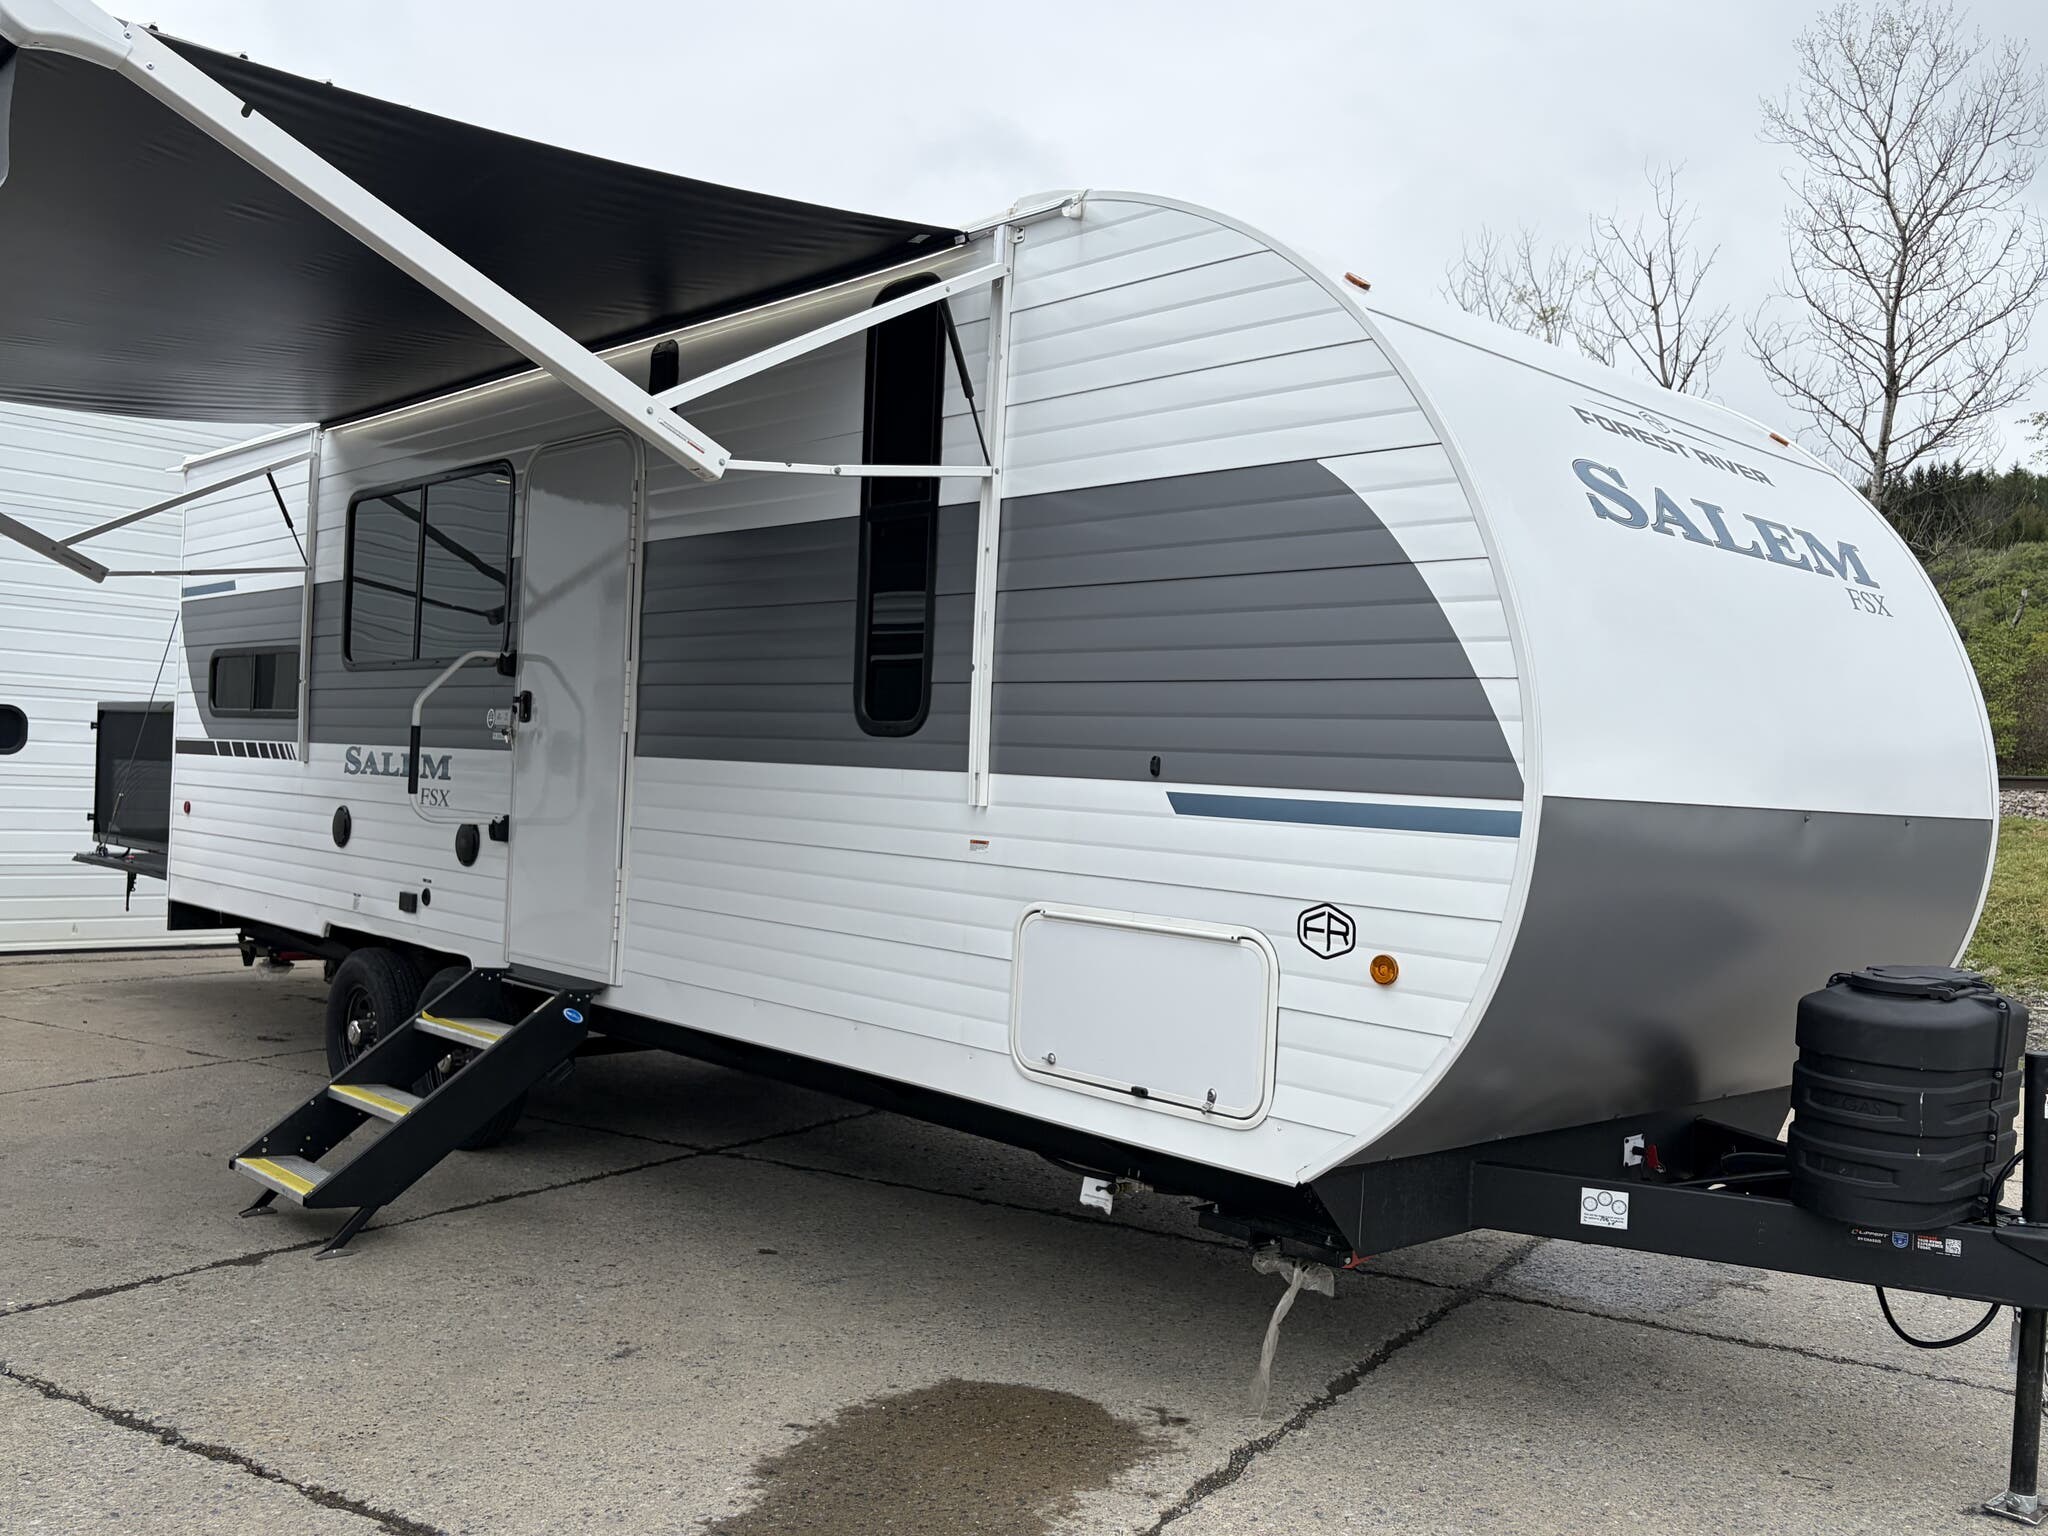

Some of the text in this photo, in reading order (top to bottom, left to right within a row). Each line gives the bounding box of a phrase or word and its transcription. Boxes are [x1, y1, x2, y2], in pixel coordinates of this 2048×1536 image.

[1569, 404, 1776, 488] FOREST RIVER
[1571, 458, 1881, 590] SALEM
[1845, 587, 1894, 618] FSX
[420, 787, 451, 807] FSX
[1303, 910, 1350, 953] FR
